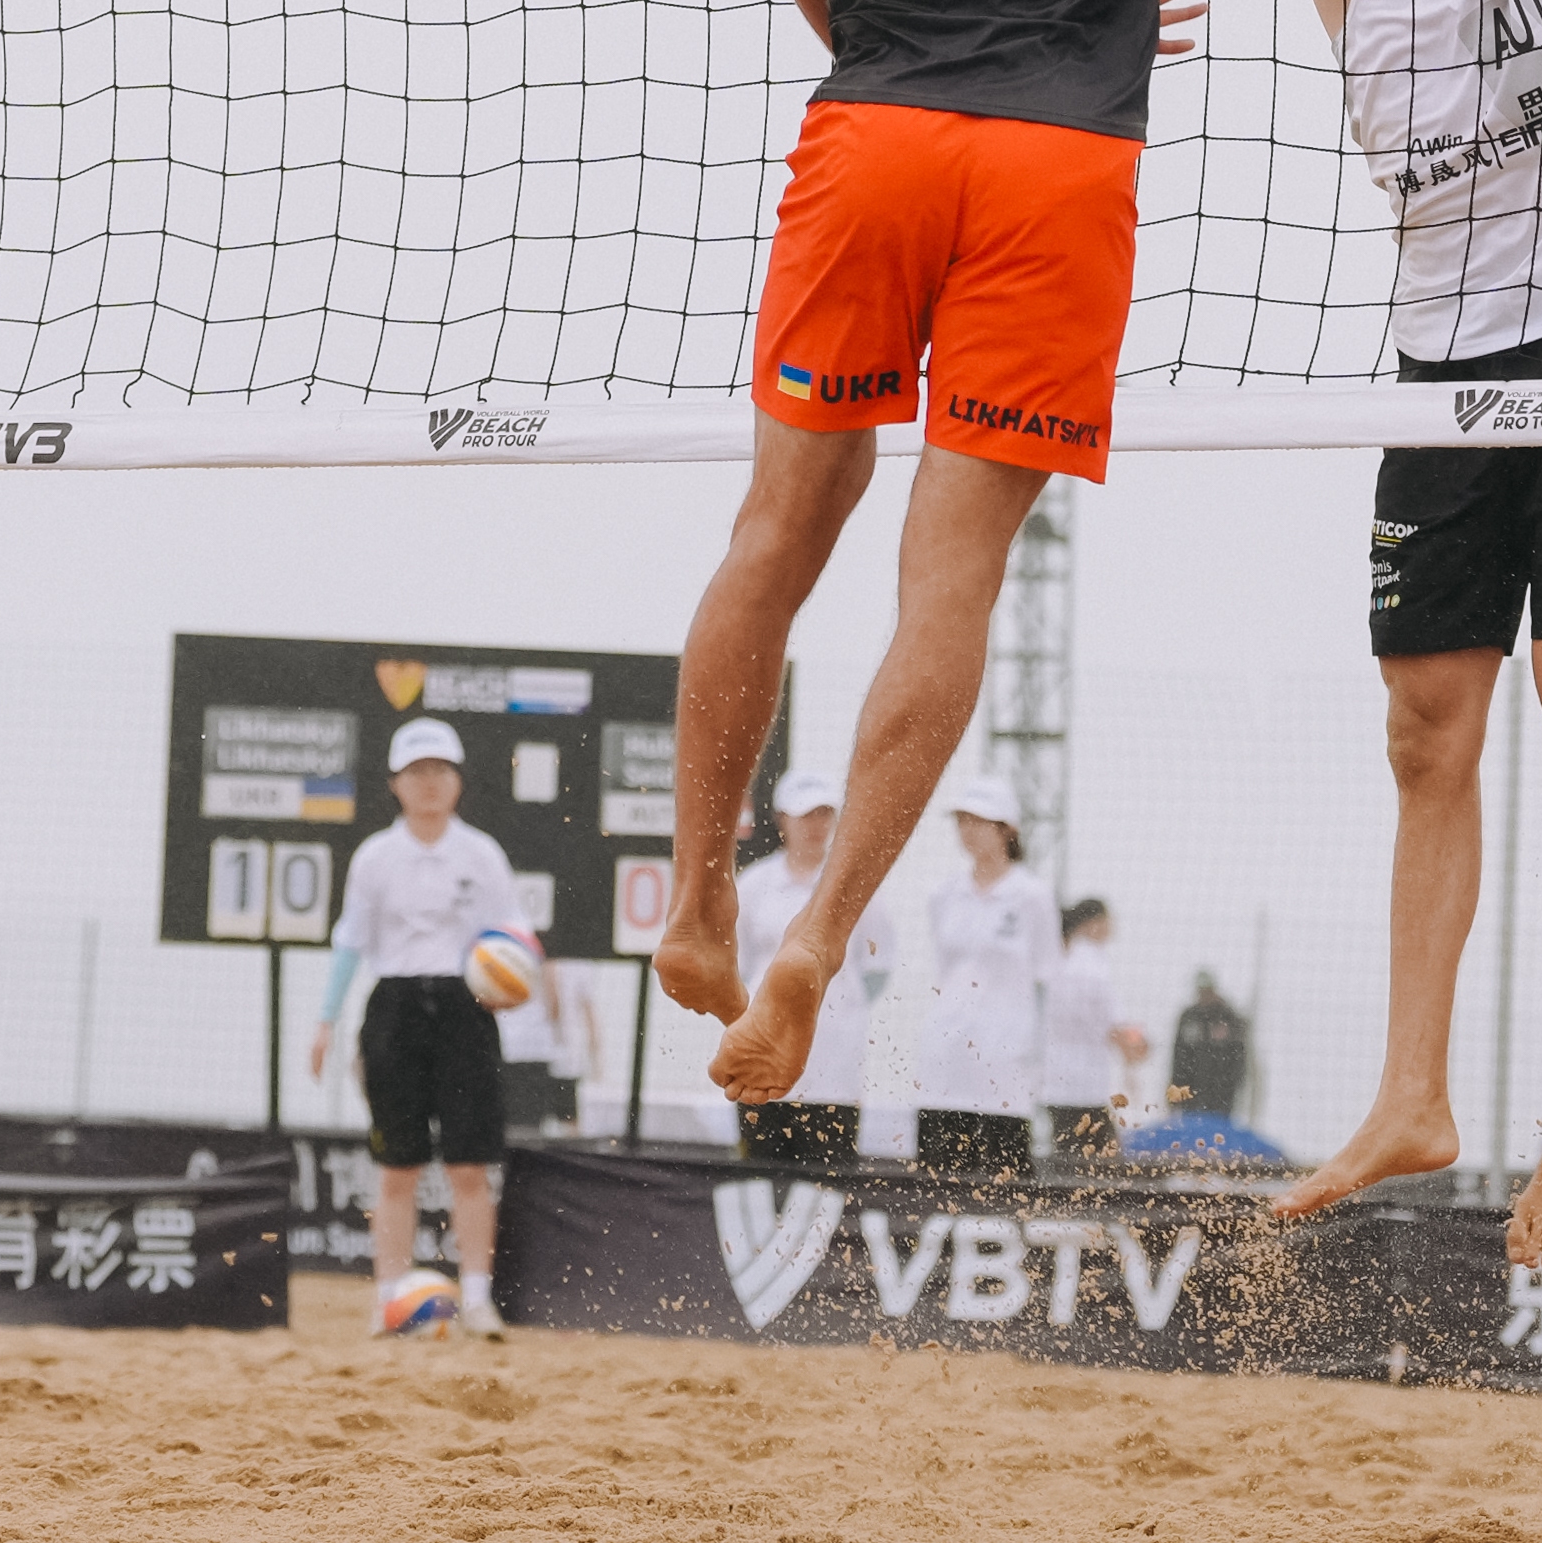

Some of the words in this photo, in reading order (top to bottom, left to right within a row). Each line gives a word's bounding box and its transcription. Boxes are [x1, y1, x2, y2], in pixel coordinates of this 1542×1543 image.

[819, 369, 902, 404] UKR
[467, 417, 548, 433] BEACH
[1493, 416, 1529, 430] PRO
[462, 435, 494, 447] PRO
[497, 434, 537, 446] TOUR
[625, 866, 665, 930] 0
[859, 1208, 1204, 1331] VBTV
